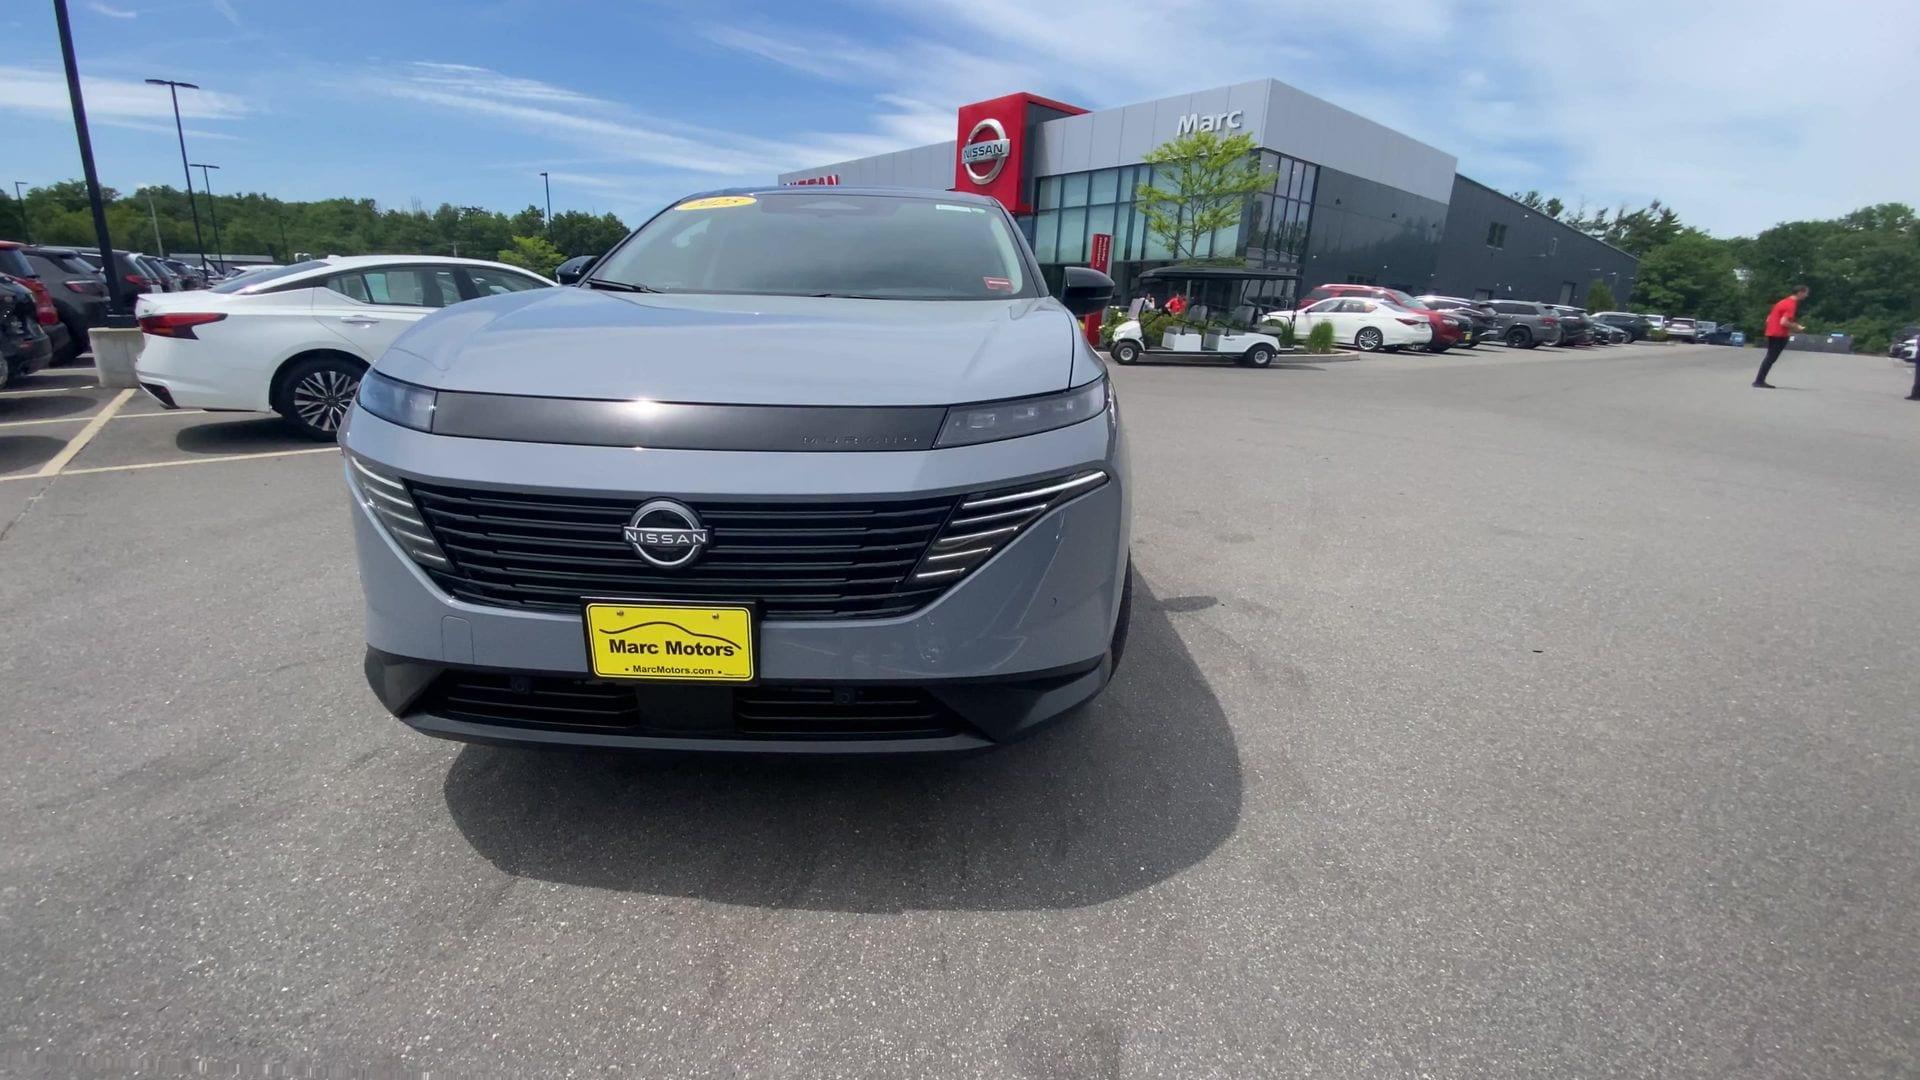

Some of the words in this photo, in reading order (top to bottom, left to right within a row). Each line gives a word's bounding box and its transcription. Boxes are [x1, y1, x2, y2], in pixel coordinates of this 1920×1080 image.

[1177, 110, 1243, 136] Marc
[963, 143, 1003, 159] NISSAN
[784, 174, 839, 186] SAN
[625, 530, 706, 544] NISSAN
[609, 639, 659, 655] Marc
[665, 641, 735, 657] Motors
[632, 665, 714, 675] MarcMotors.com
